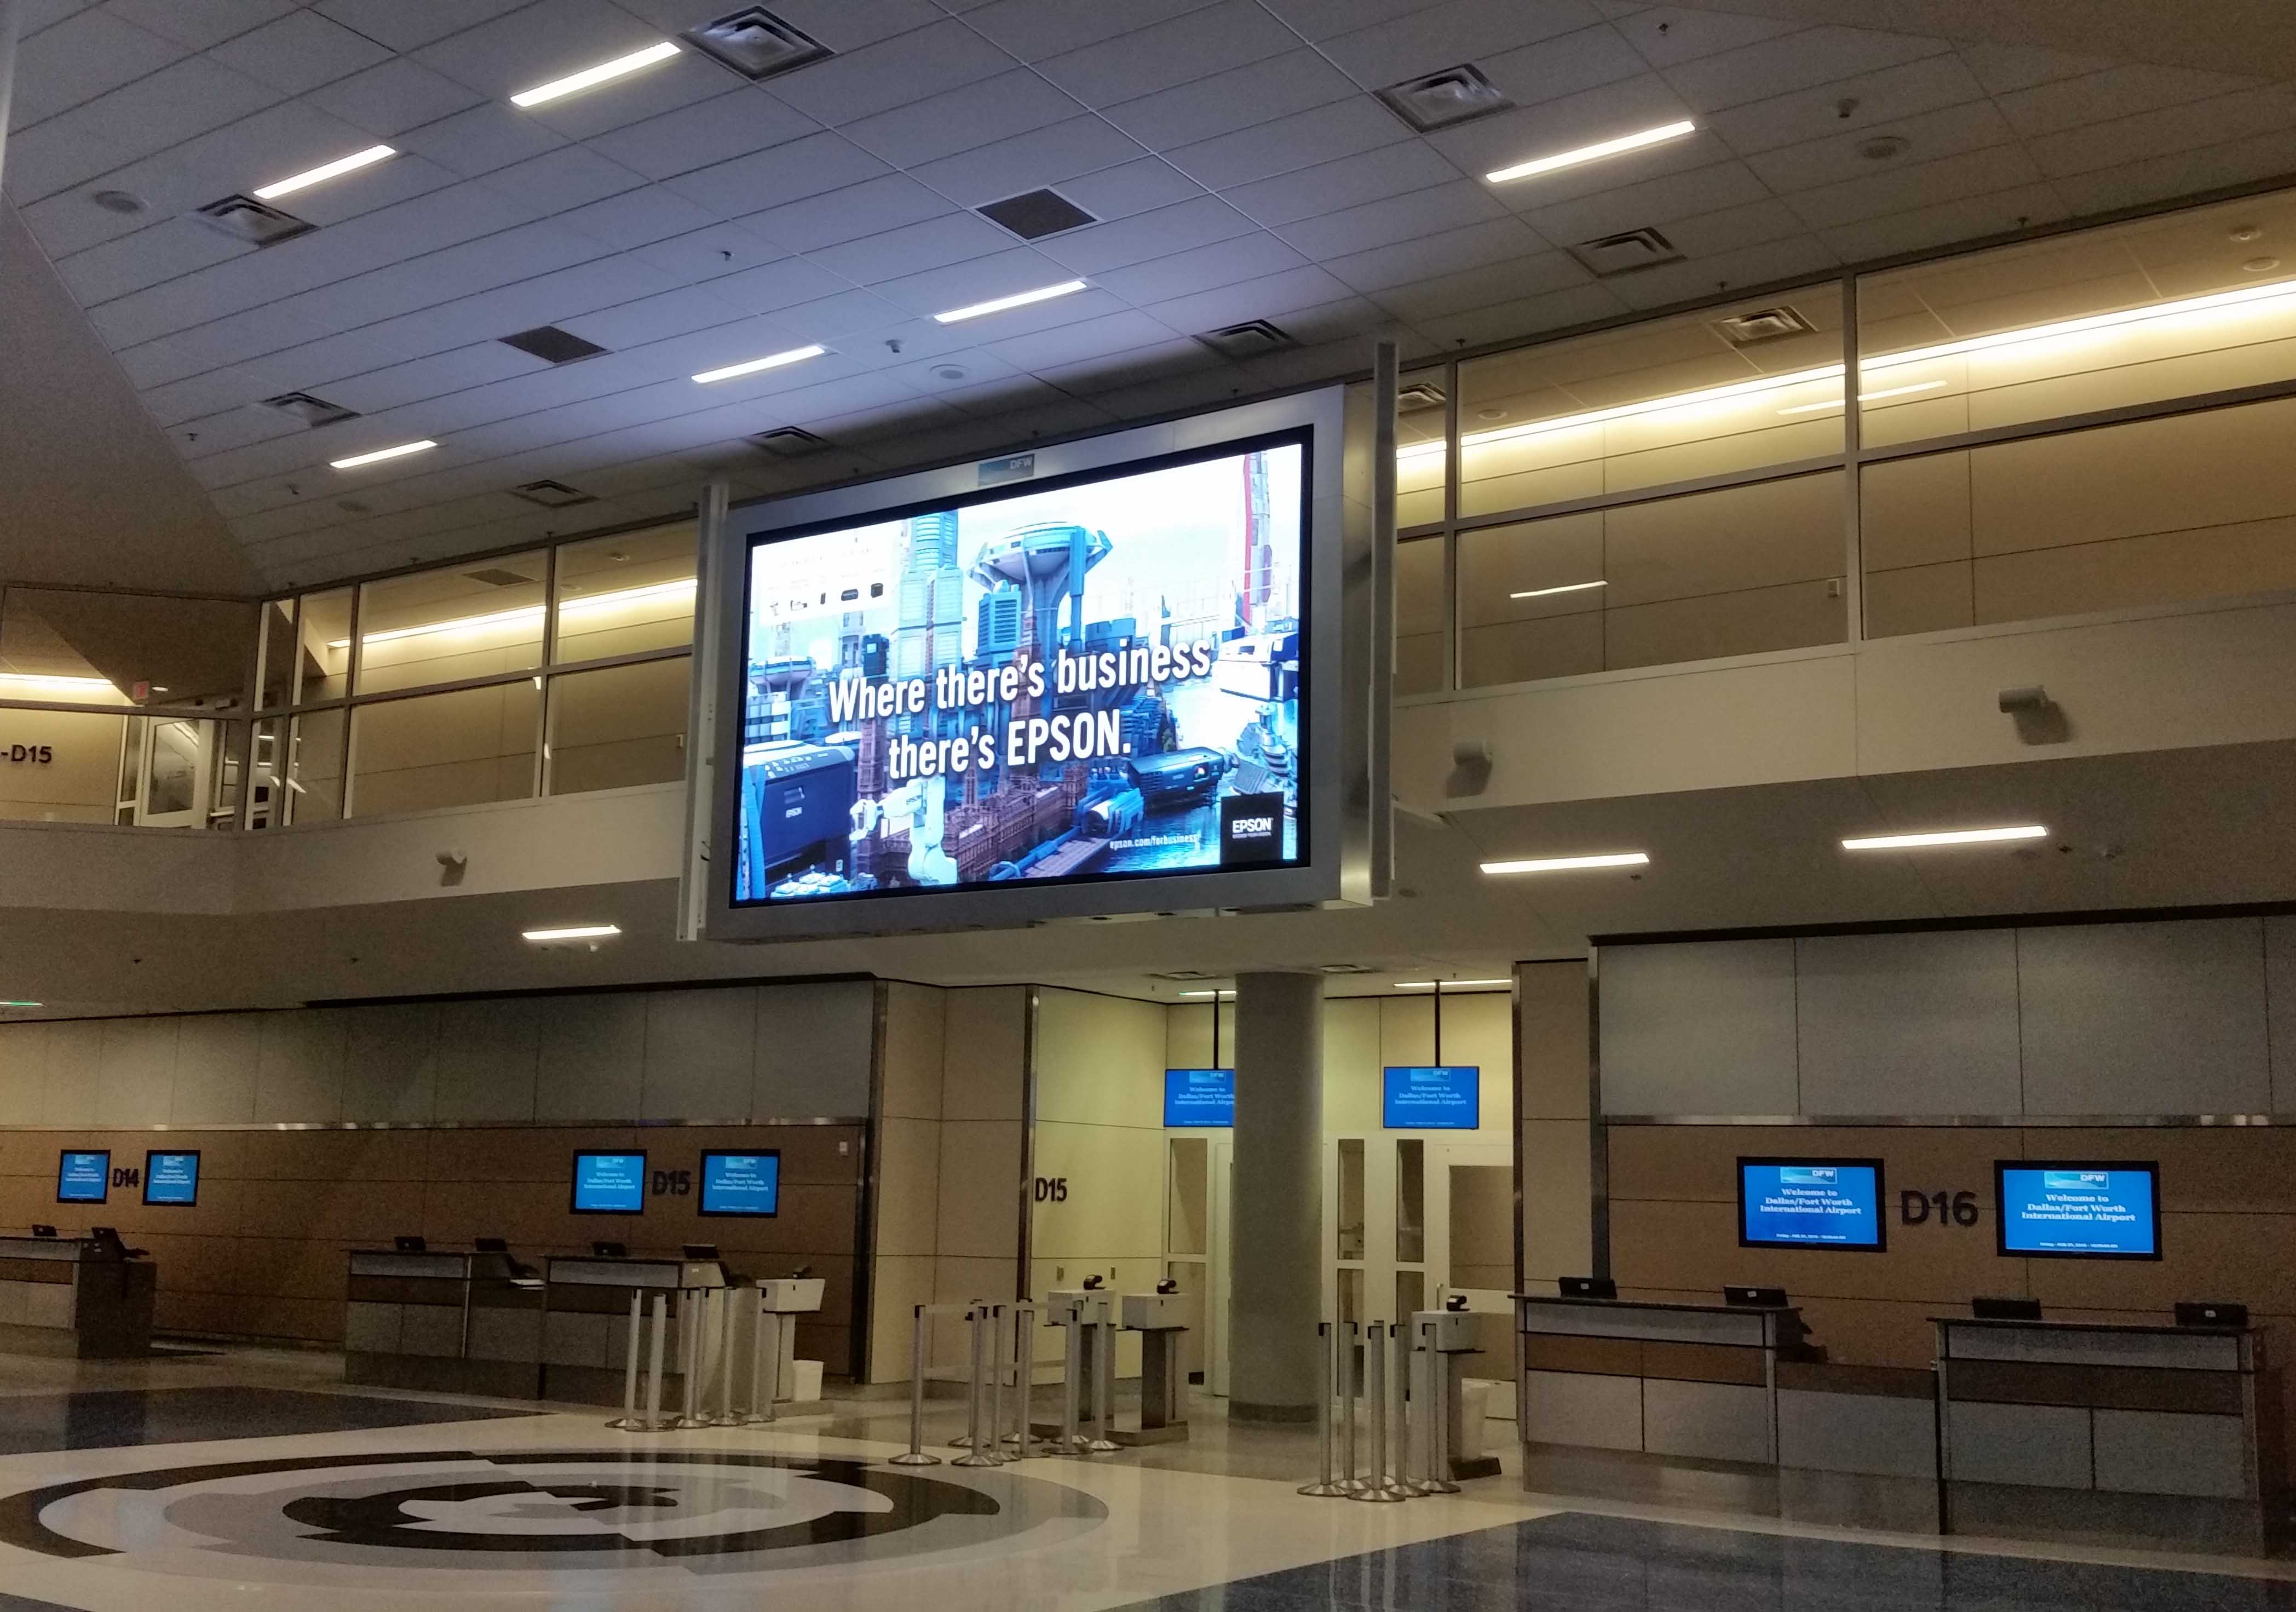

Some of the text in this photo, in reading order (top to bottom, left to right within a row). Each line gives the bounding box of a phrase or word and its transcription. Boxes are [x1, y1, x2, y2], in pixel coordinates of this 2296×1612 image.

[1010, 457, 1033, 469] DFW
[828, 639, 1211, 722] Where there's business
[889, 709, 1131, 779] there's EPSON.
[1233, 817, 1272, 833] EPSON
[1109, 833, 1199, 851] epson.com/forbusiness
[112, 1168, 139, 1188] D14
[653, 1171, 691, 1195] D15
[1035, 1178, 1067, 1202] D15
[1781, 1188, 1825, 1196] Welcome
[1760, 1205, 1862, 1215] International Airport
[1765, 1197, 1820, 1206] Dallas/Fort
[1902, 1191, 1978, 1226] D16
[2027, 1203, 2126, 1213] Dallas/Fort Worth
[2022, 1212, 2136, 1223] International Airport
